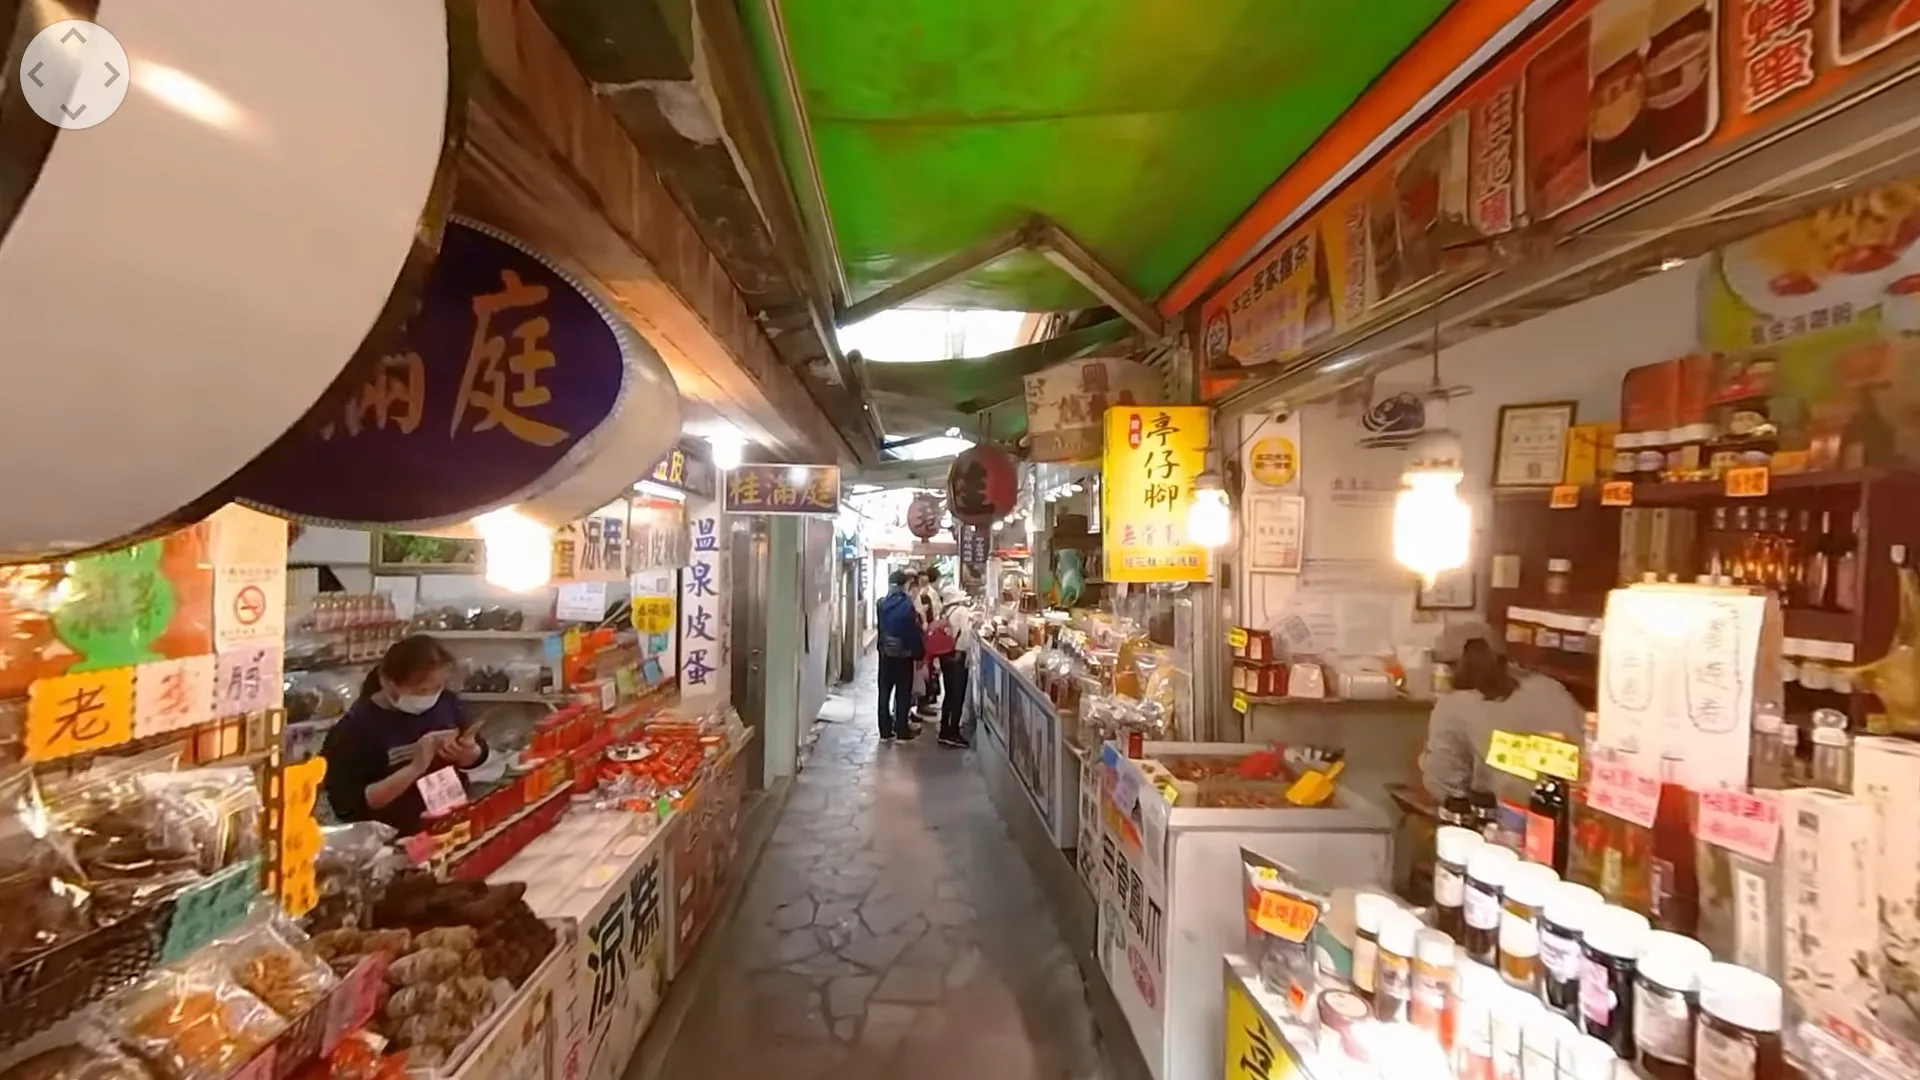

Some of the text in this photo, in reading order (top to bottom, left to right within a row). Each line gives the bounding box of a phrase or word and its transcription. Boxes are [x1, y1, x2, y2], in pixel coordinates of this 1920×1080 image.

[728, 471, 835, 509] 桂滿庭
[1144, 411, 1181, 513] 亭仔腳
[46, 684, 110, 748] 老
[587, 855, 660, 1035] 涼糕
